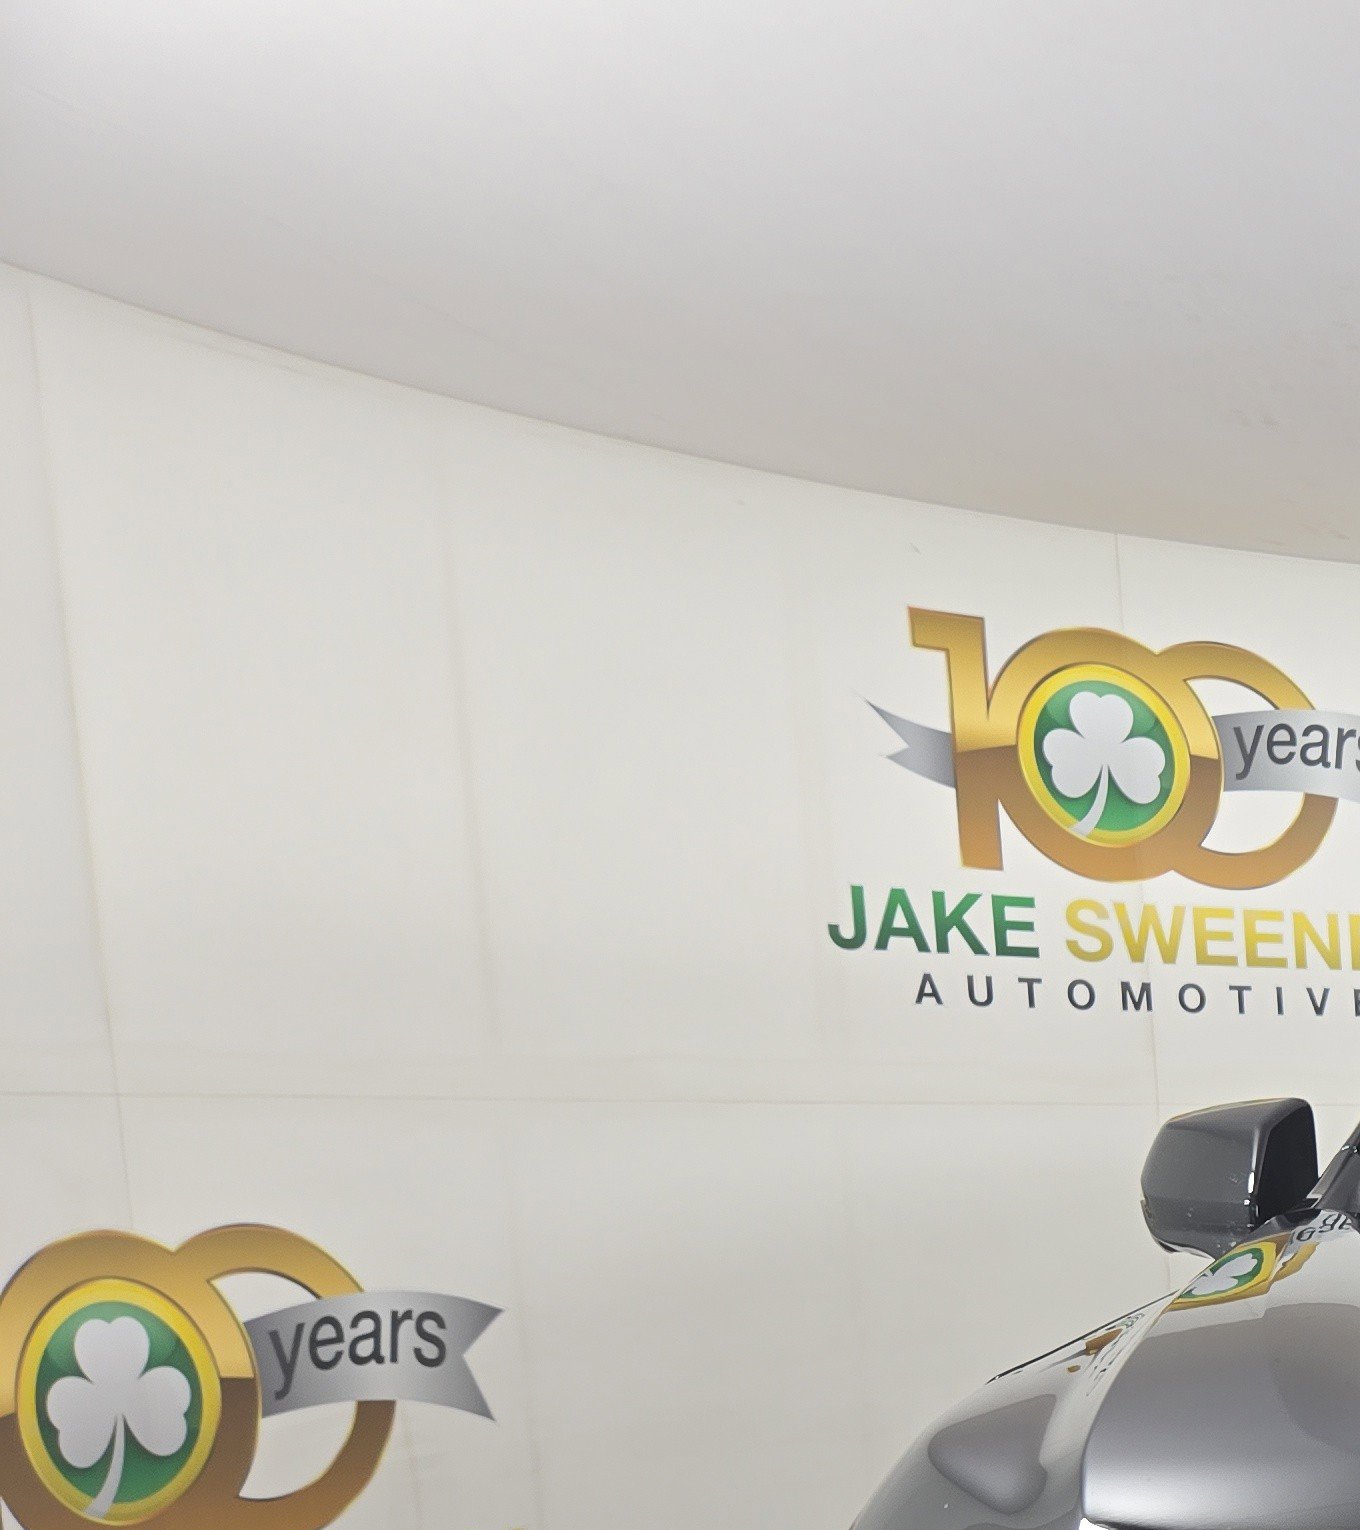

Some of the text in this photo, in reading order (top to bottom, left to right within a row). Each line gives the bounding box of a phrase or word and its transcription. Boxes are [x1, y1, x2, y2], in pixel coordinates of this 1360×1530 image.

[907, 606, 1338, 890] 100
[828, 885, 1040, 958] JAKE
[269, 1309, 447, 1399] years
